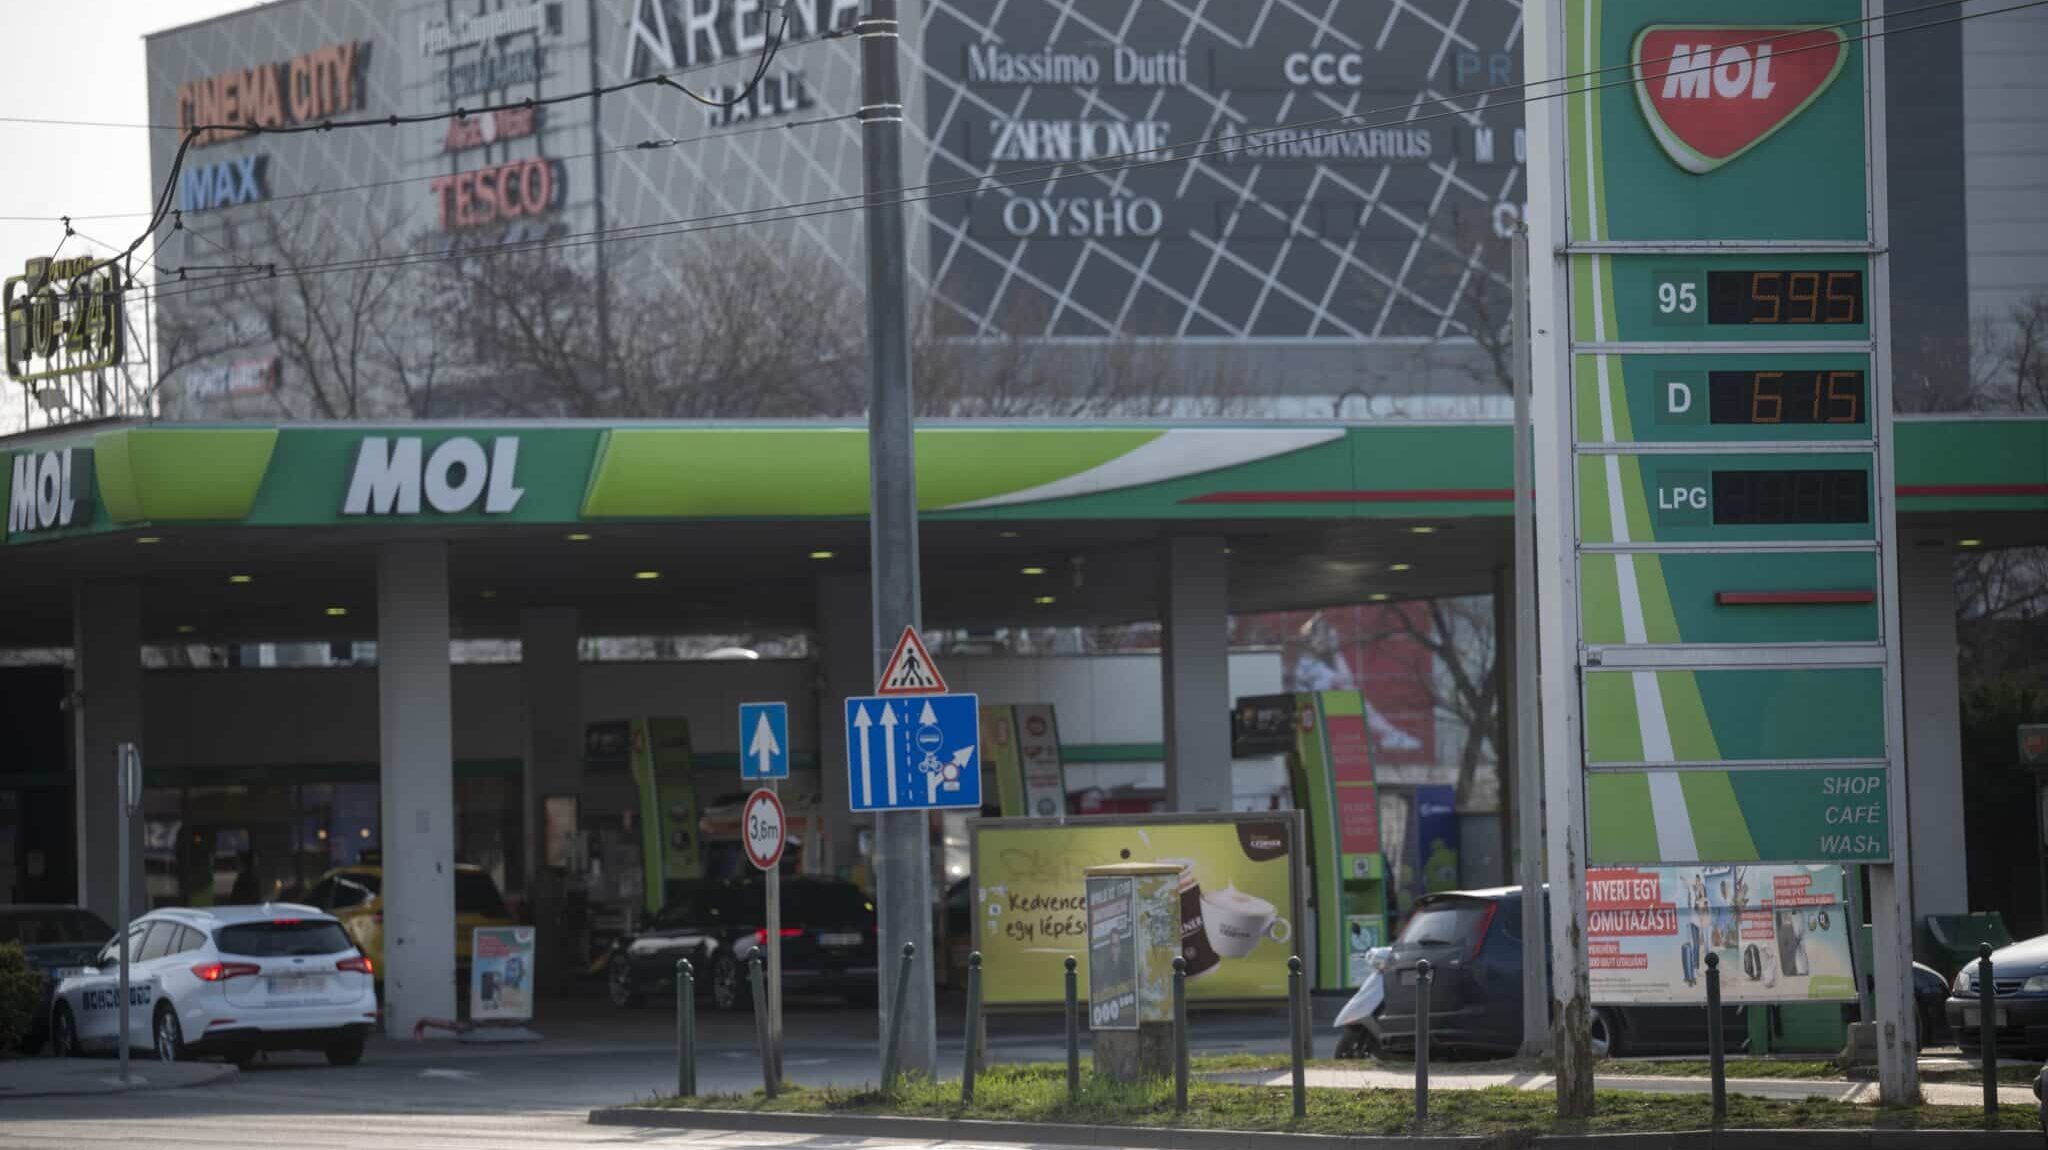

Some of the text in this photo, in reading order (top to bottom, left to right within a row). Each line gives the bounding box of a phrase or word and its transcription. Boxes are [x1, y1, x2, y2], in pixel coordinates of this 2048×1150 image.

[289, 42, 358, 122] CITY
[968, 45, 1189, 84] Massimo Dutti
[1284, 53, 1363, 85] CCC
[1662, 44, 1777, 99] MOL
[182, 155, 259, 212] IMAX
[430, 156, 550, 230] TESCO
[1003, 197, 1162, 237] OYSHO
[1658, 283, 1697, 313] 95
[1750, 272, 1856, 323] 595
[1668, 382, 1692, 414] D
[1751, 372, 1857, 423] 615
[8, 448, 75, 531] MOL
[343, 437, 525, 514] MOL
[1658, 488, 1707, 510] LPG
[1823, 777, 1880, 795] SHOP
[750, 815, 778, 841] 3,6m
[1825, 800, 1881, 825] CAFÉ
[1592, 880, 1630, 901] NYERJ
[1633, 879, 1657, 900] EGY
[1006, 921, 1034, 941] egy
[1587, 904, 1677, 932] OMUTAZÁST!
